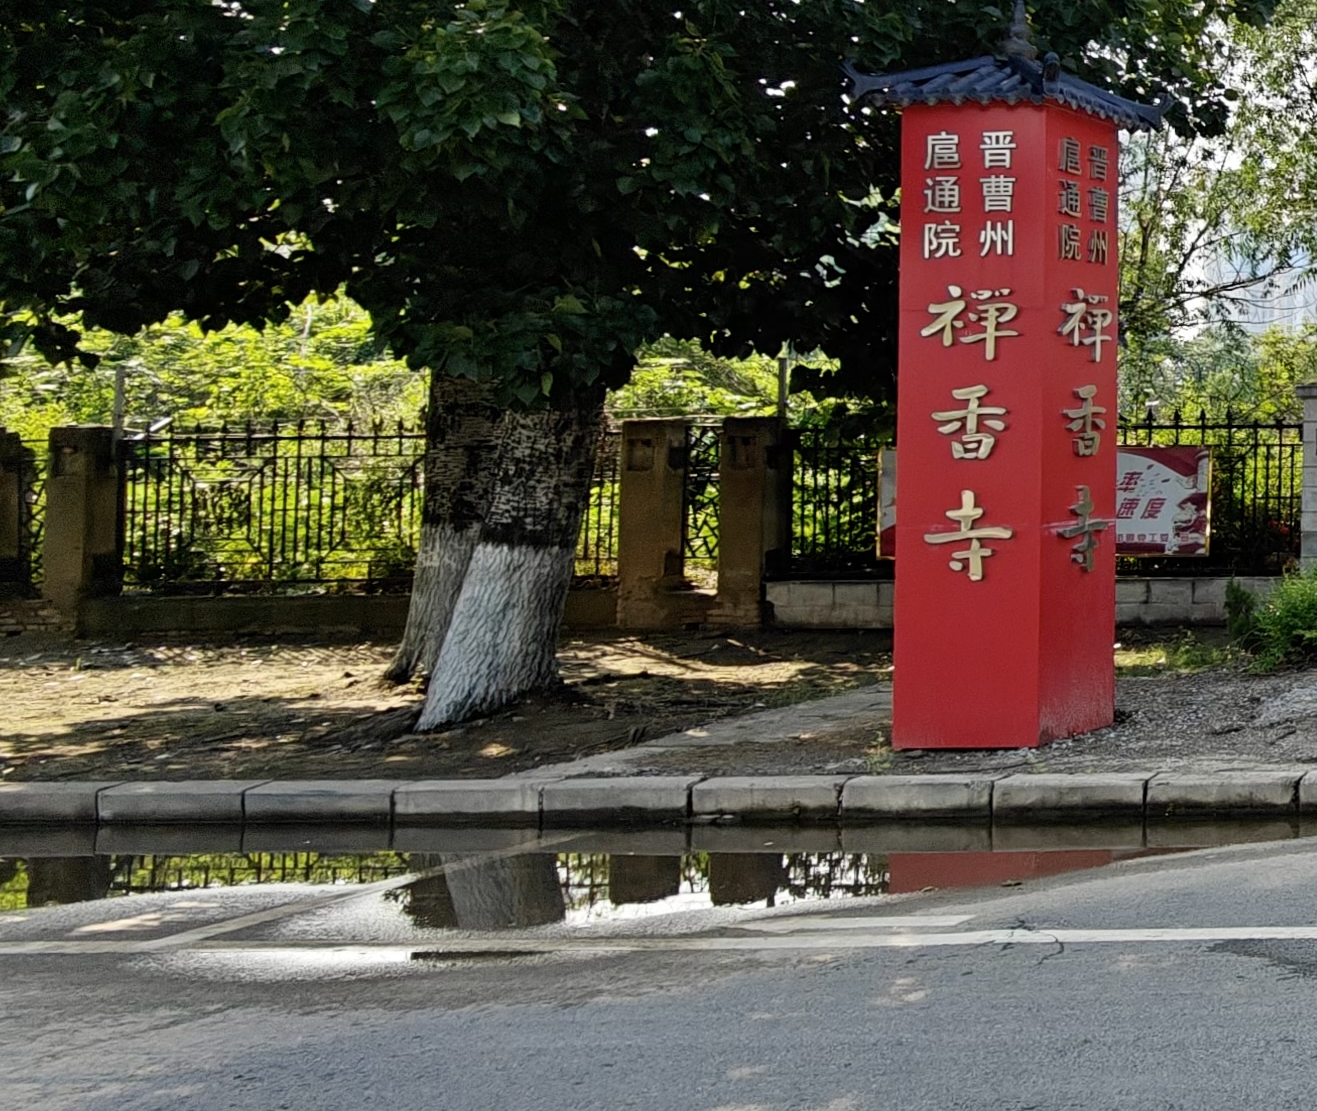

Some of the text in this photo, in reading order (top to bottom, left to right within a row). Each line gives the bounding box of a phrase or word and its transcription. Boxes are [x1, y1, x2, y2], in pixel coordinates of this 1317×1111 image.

[923, 131, 962, 260] 扈通院
[979, 130, 1017, 258] 晋曹州
[1059, 137, 1083, 262] 扈通院
[1088, 145, 1110, 265] 晋曹州
